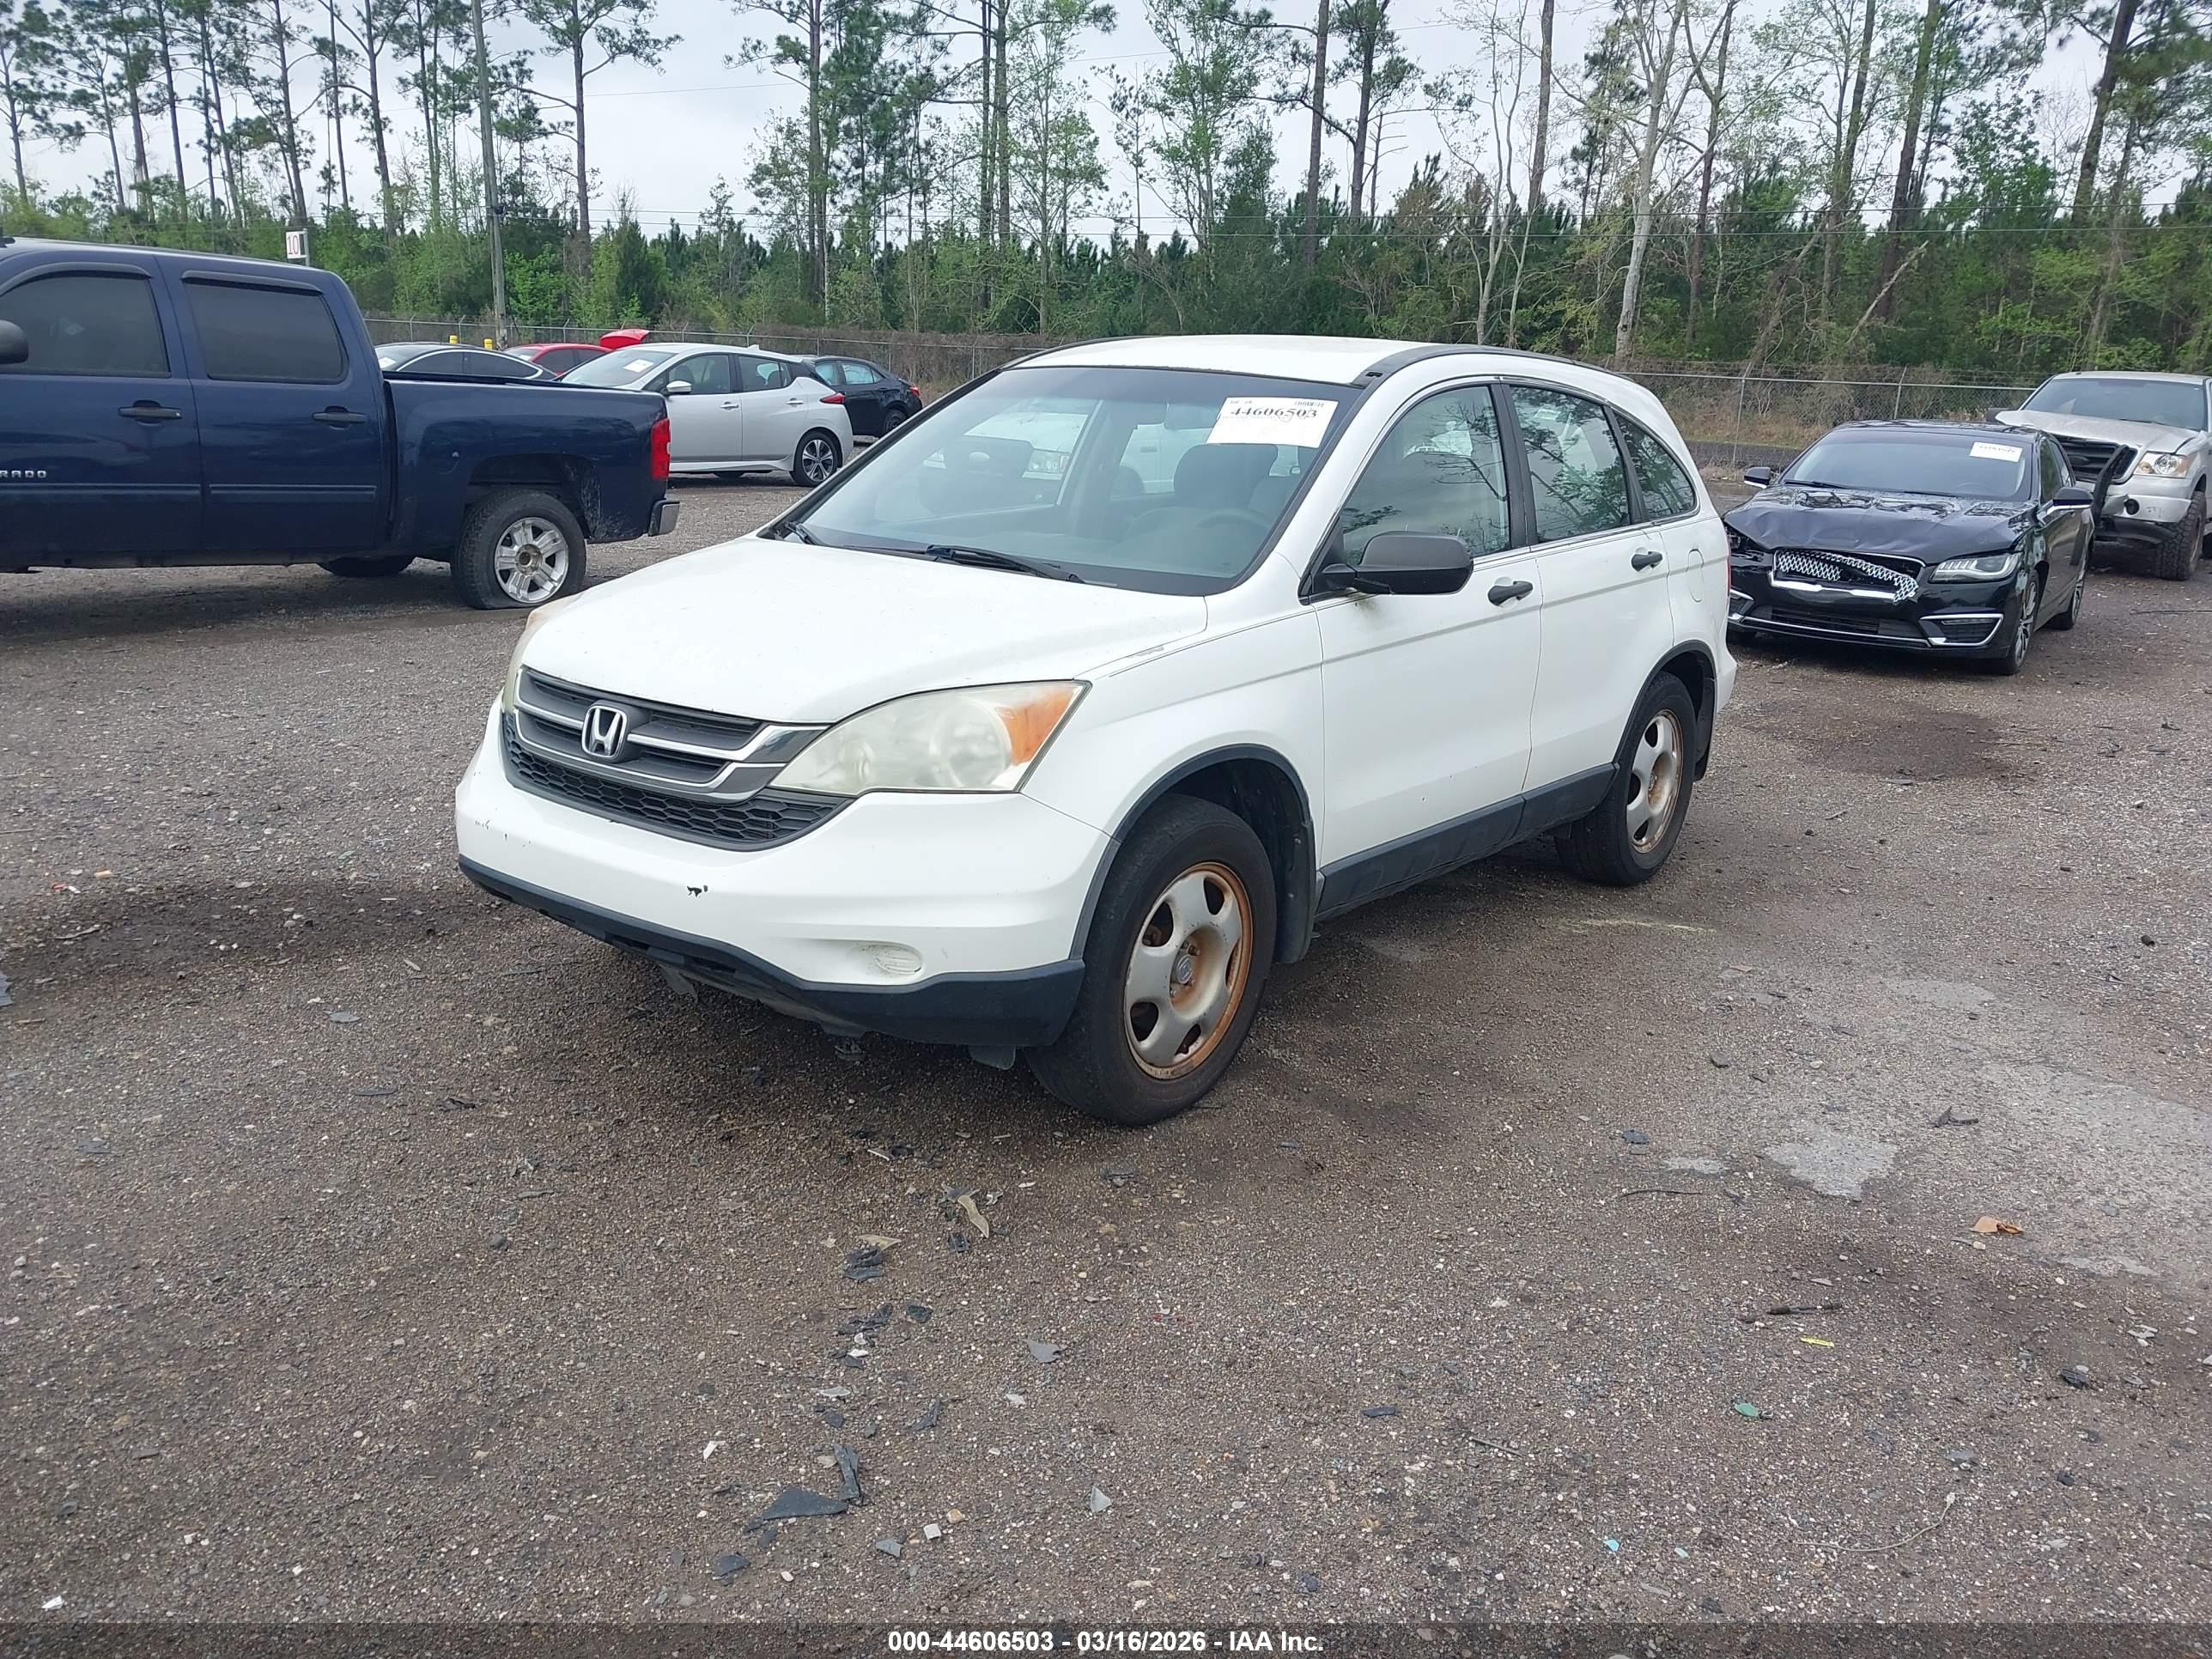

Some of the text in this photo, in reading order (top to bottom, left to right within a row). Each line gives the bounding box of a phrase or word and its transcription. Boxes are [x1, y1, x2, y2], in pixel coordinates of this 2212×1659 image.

[287, 234, 300, 255] 10
[1231, 407, 1318, 419] 44606503
[0, 470, 46, 478] RADO
